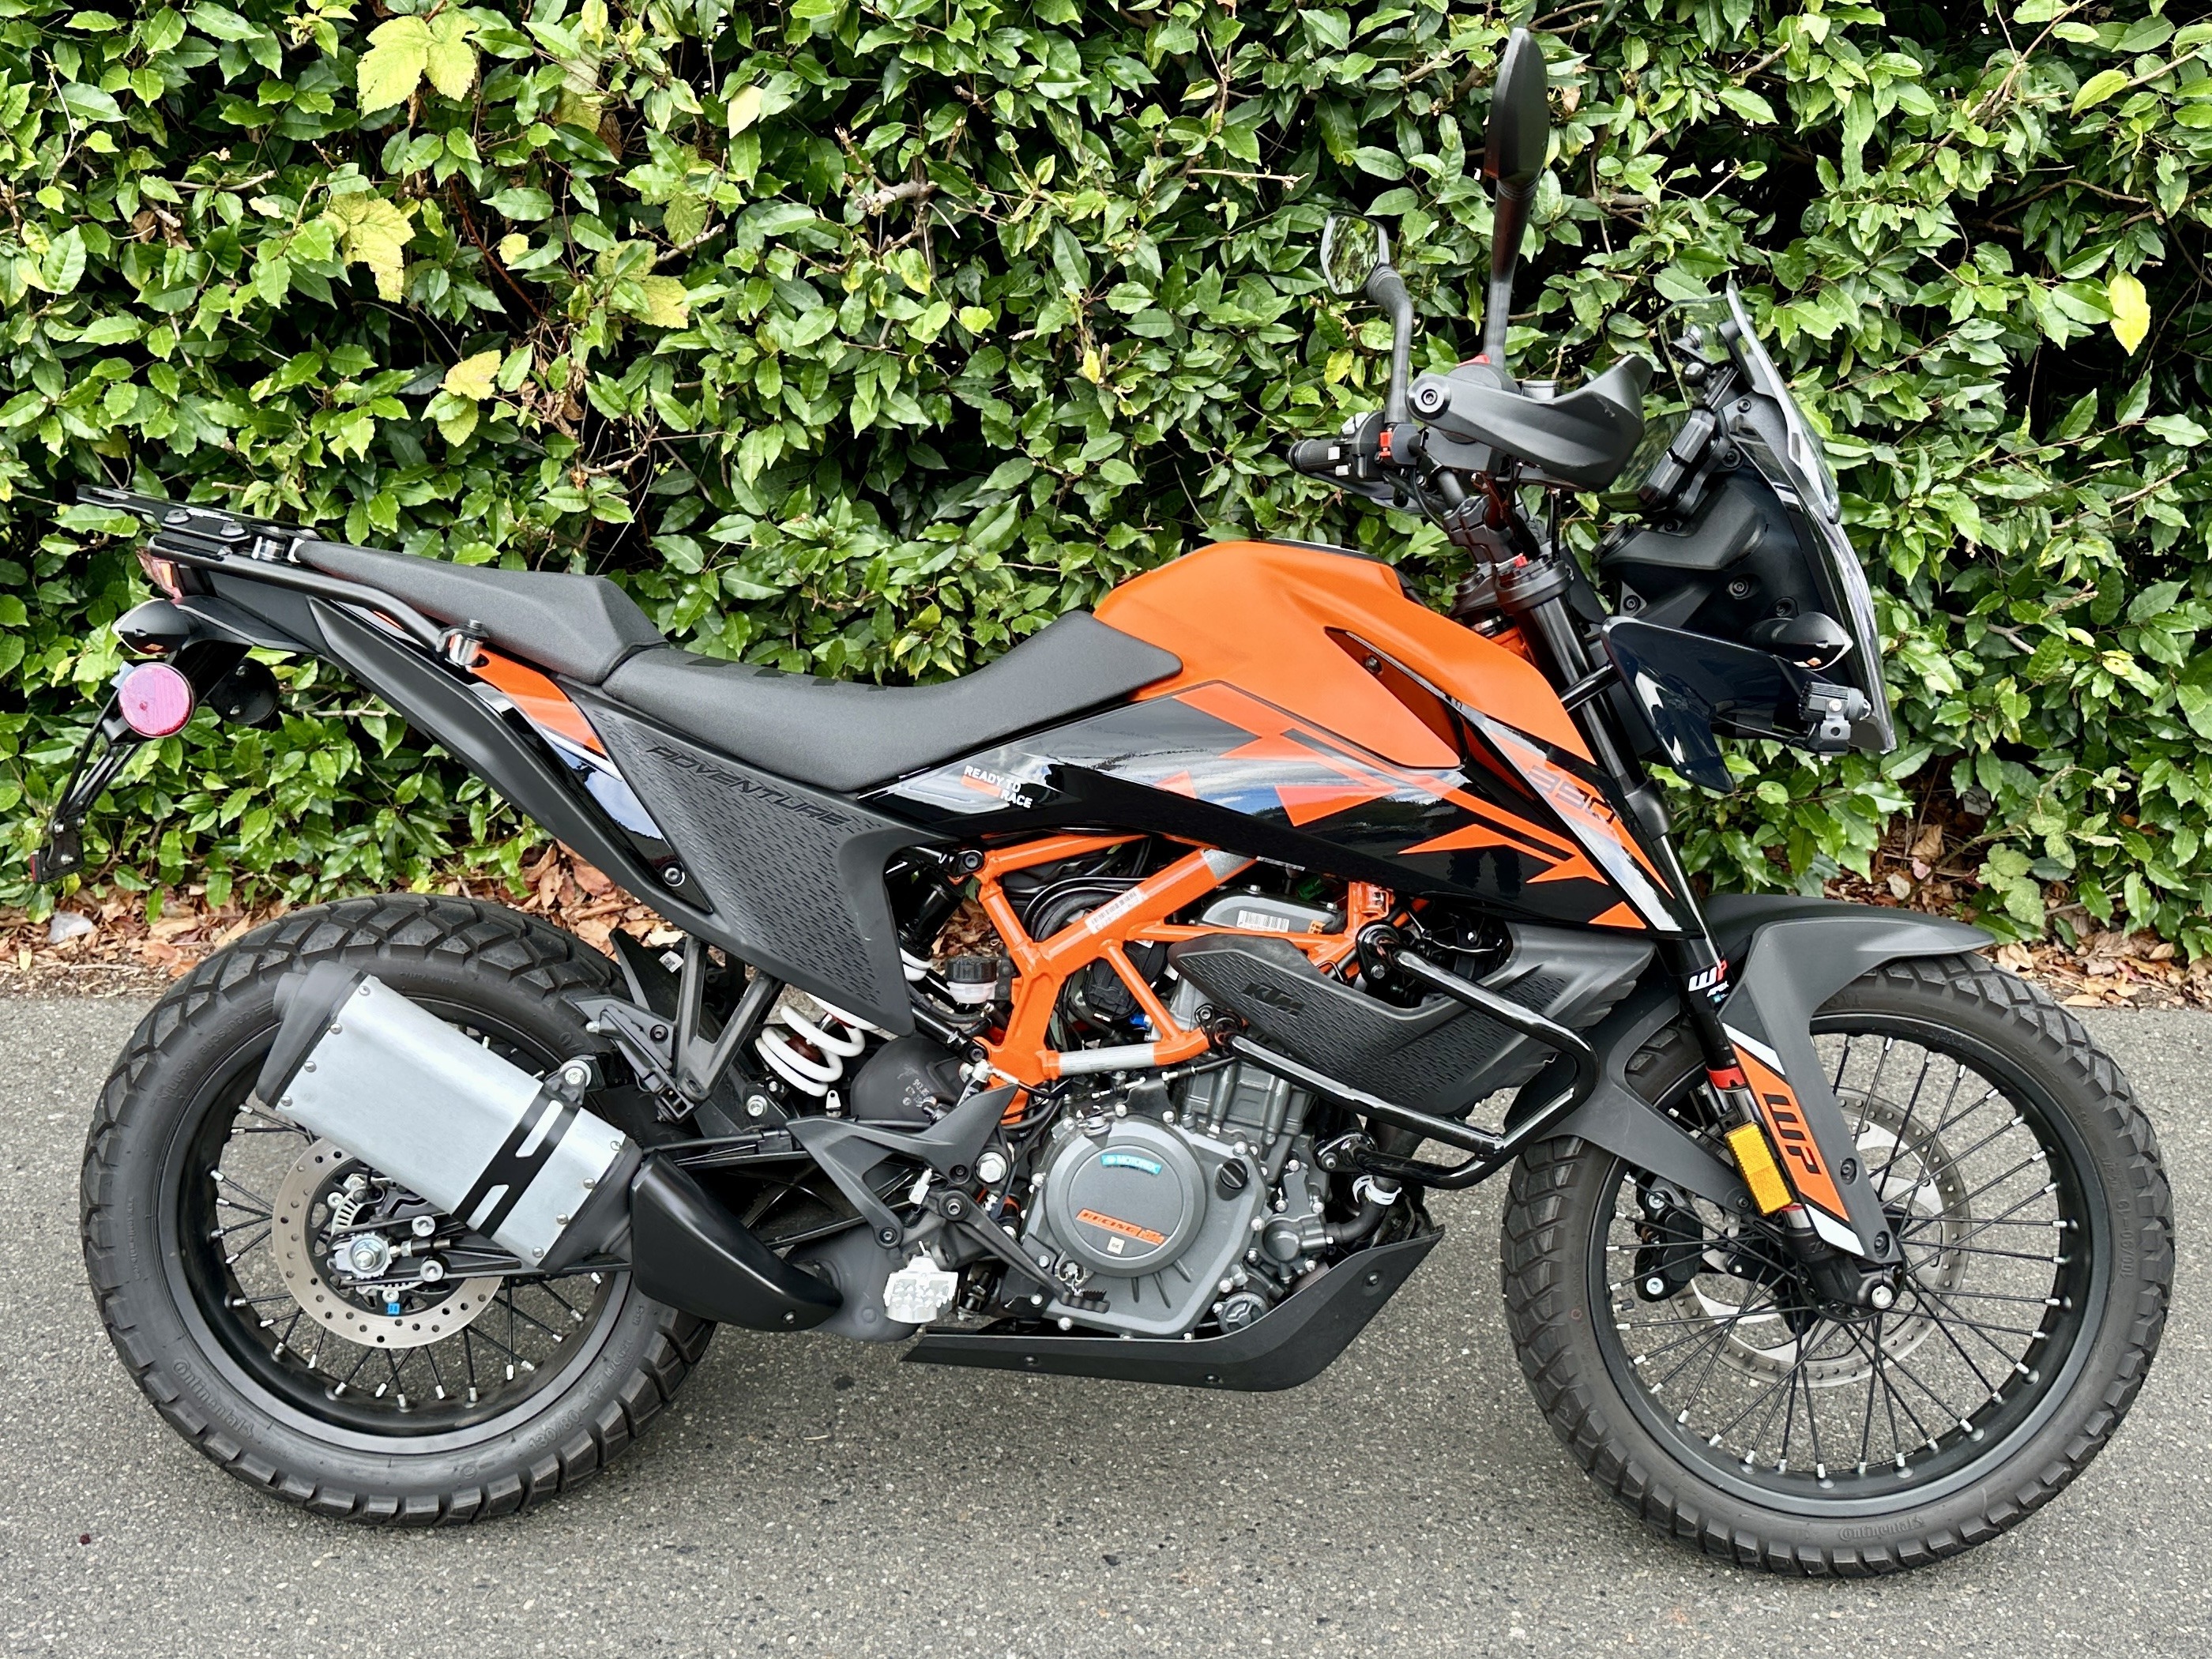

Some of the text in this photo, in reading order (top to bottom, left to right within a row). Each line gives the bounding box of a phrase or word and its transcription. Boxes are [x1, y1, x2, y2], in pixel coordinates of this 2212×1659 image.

[646, 746, 852, 826] ADVENTURE
[964, 765, 1021, 793] READY TO
[1528, 765, 1616, 825] 390
[1000, 788, 1033, 809] RACE
[1688, 959, 1728, 991] WP
[1241, 982, 1306, 1019] KTM
[1762, 1093, 1822, 1175] WP
[172, 1358, 246, 1432] Continental
[1838, 1517, 1914, 1542] Continental
